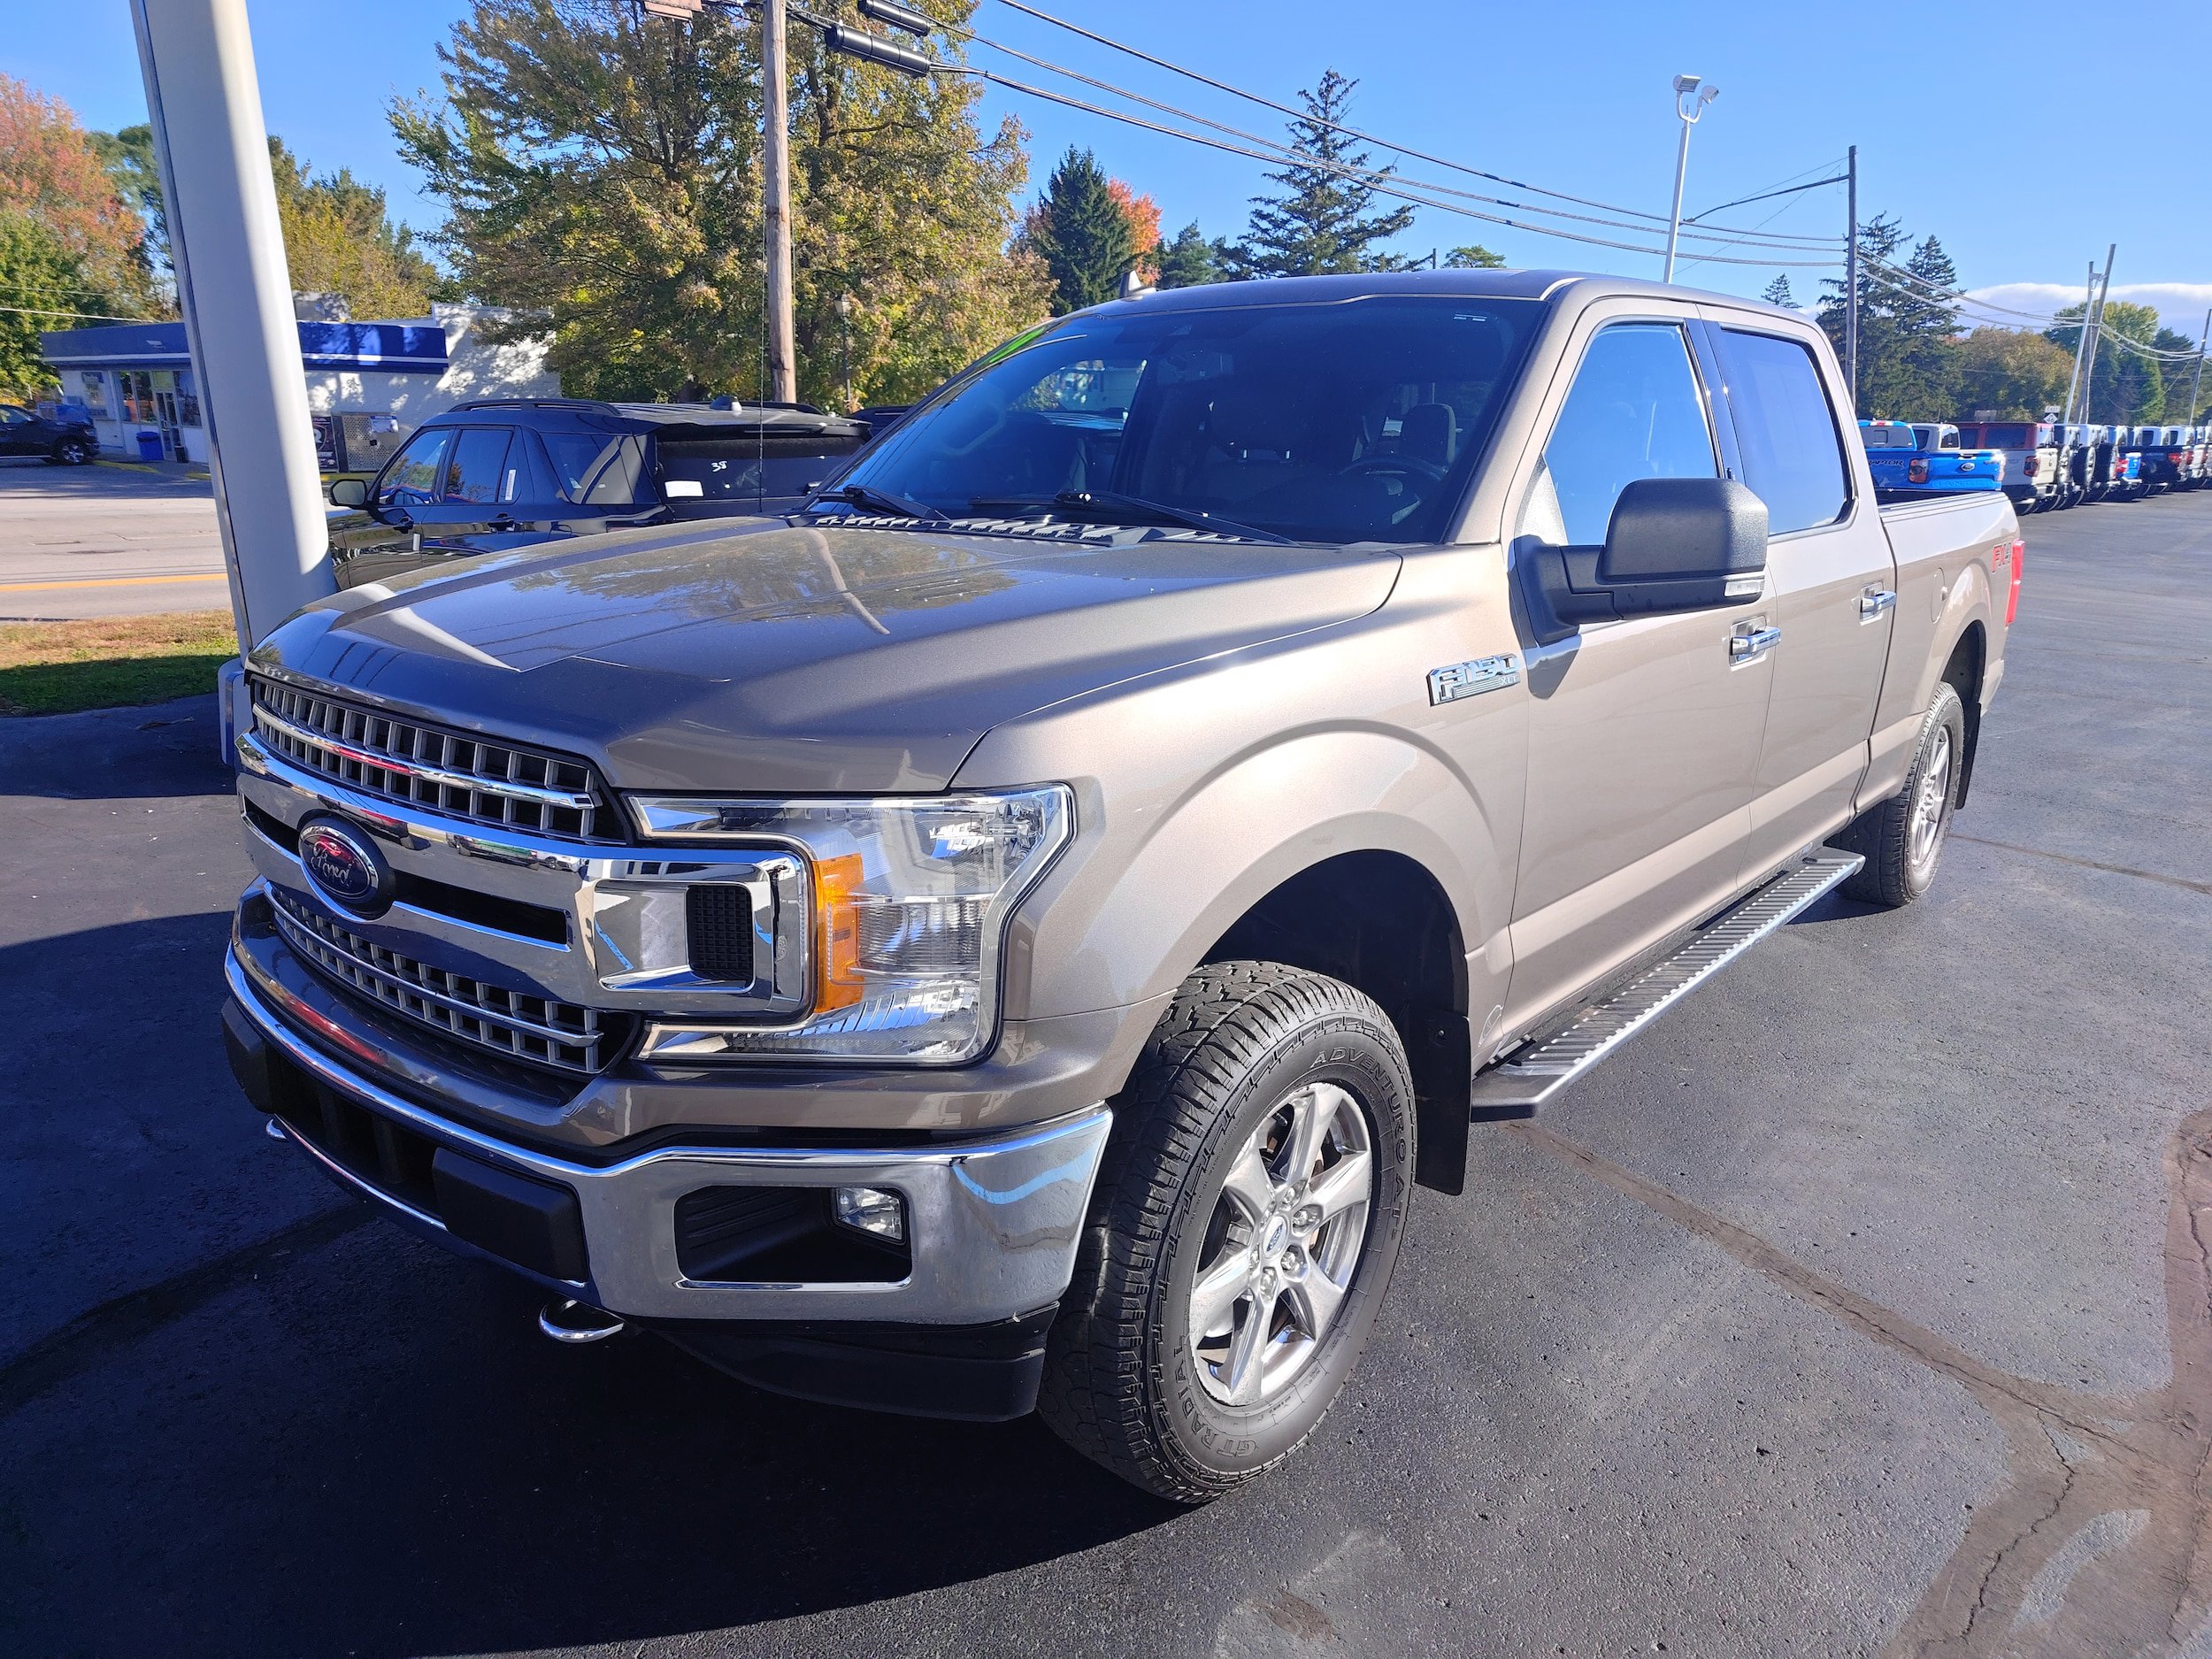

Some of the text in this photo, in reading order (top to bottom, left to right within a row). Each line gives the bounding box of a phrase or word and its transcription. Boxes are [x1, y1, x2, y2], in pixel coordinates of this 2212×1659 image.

[1991, 541, 2012, 574] FX4
[1500, 675, 1517, 686] XLT
[310, 841, 356, 887] Ford
[1310, 1046, 1407, 1164] ADVENTURO
[1173, 1334, 1260, 1458] GT RADIAL
